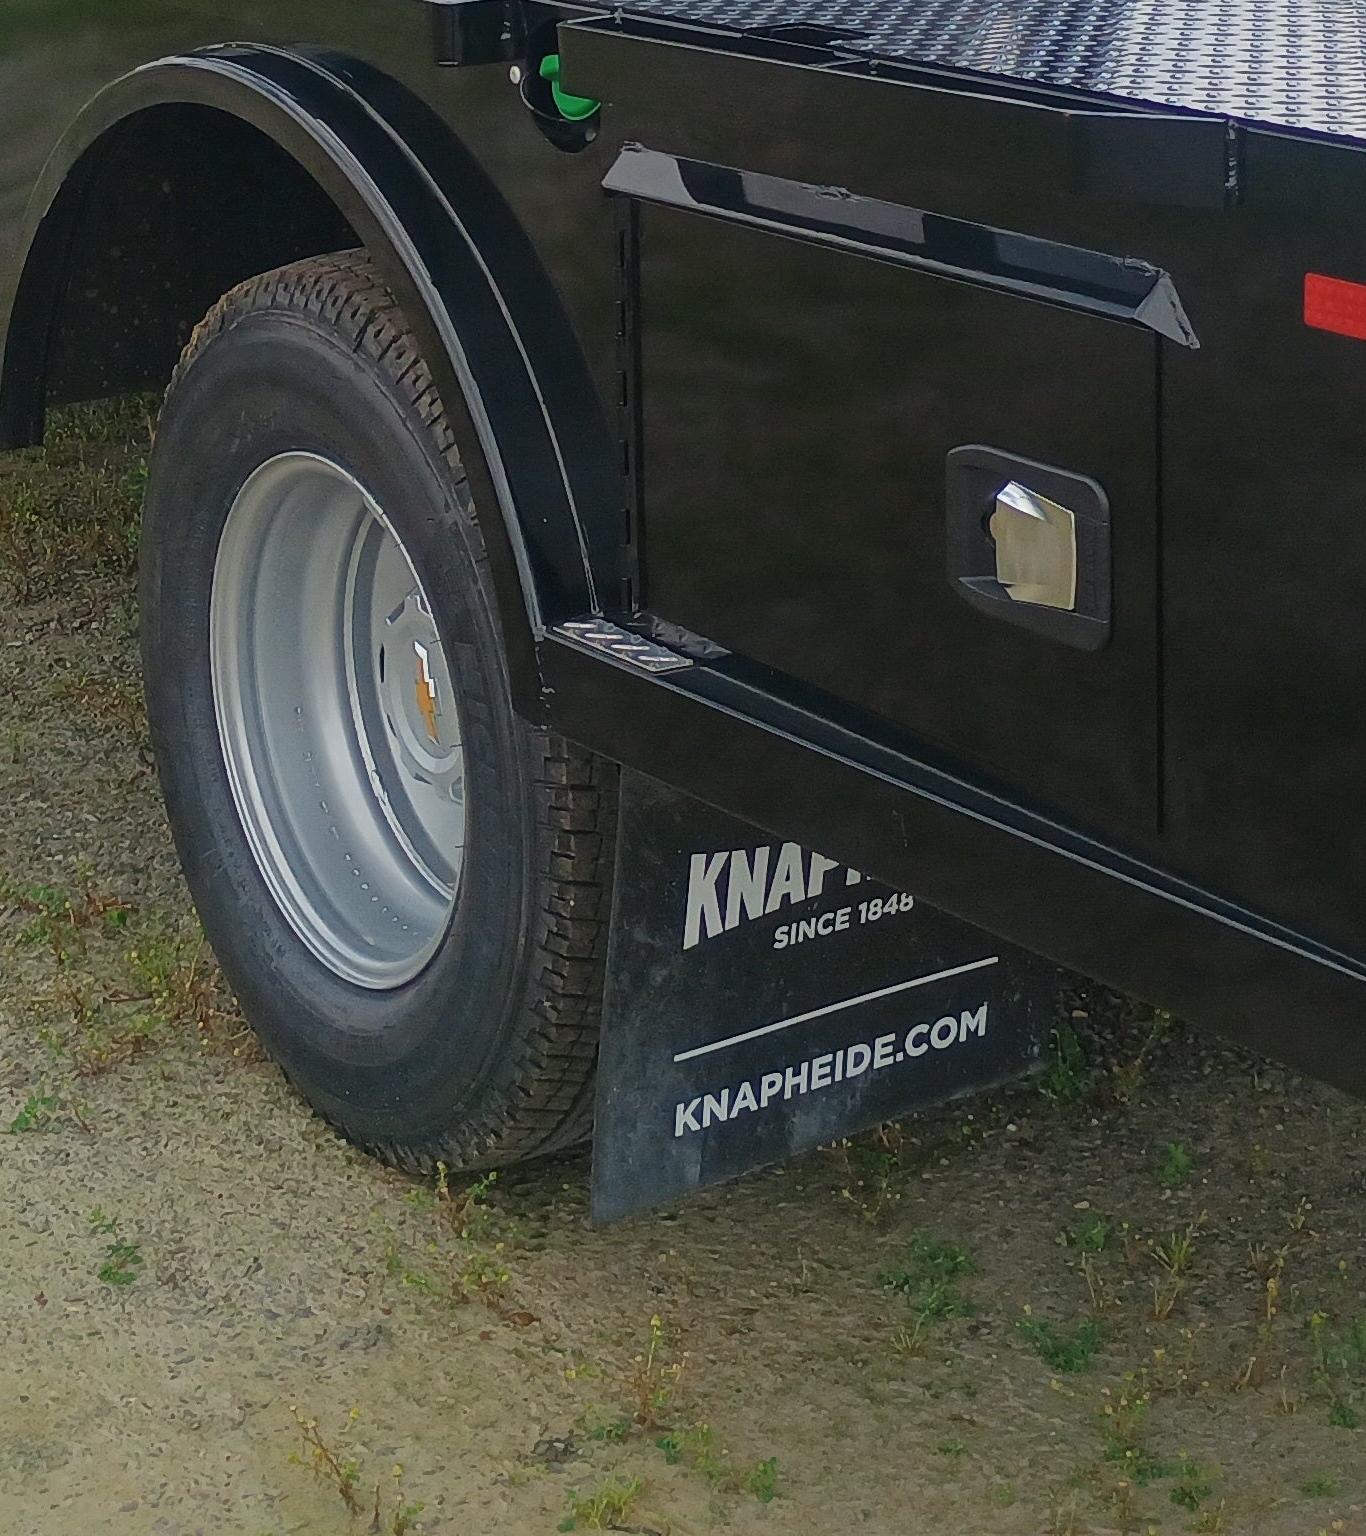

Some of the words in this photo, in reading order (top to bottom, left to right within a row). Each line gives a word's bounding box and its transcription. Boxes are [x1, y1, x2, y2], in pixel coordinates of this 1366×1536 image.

[773, 907, 851, 949] SINCE
[858, 892, 915, 924] 1848
[674, 1002, 989, 1138] KNAPHEIDE.COM
